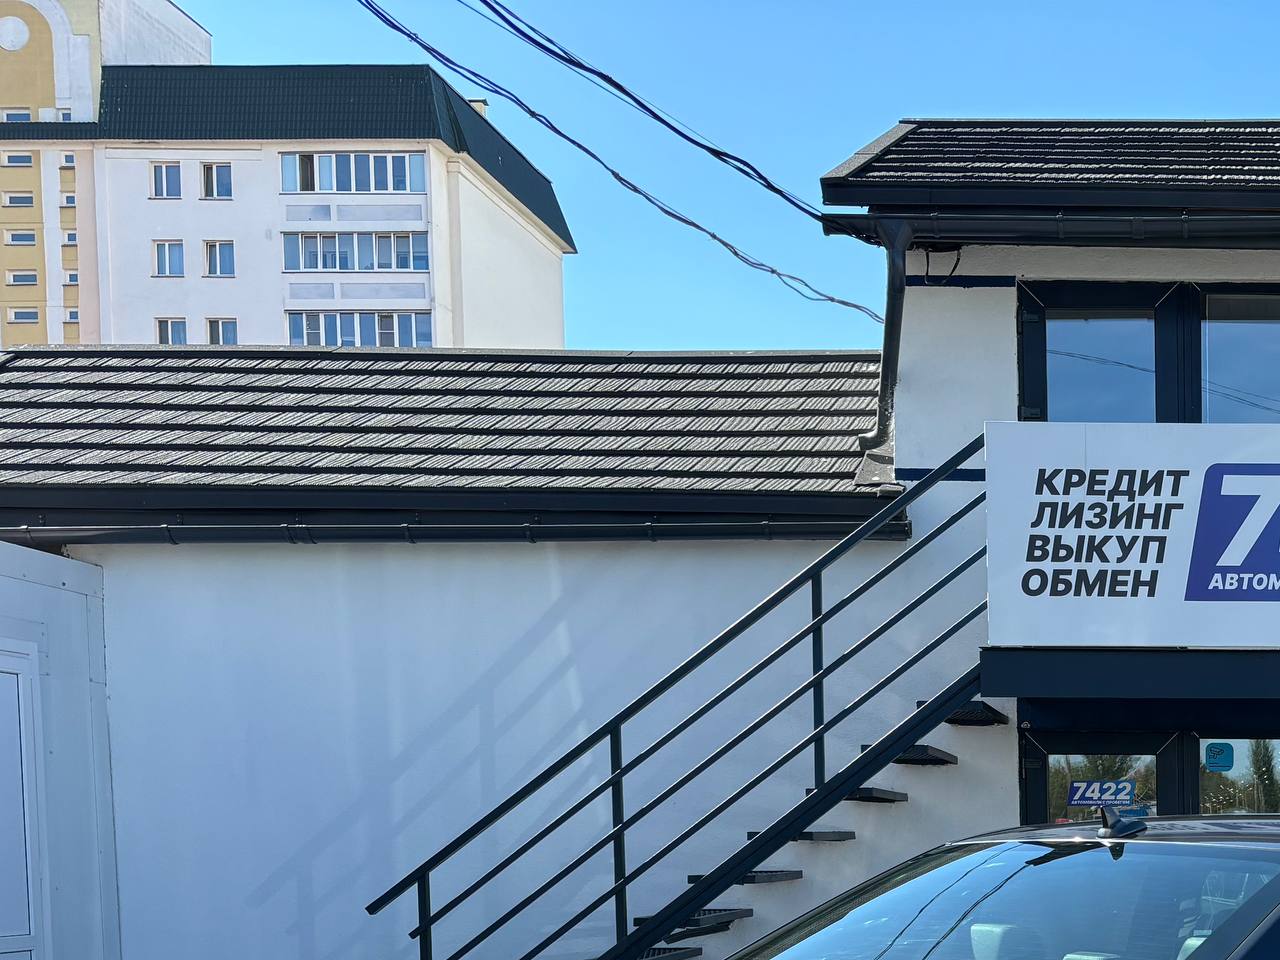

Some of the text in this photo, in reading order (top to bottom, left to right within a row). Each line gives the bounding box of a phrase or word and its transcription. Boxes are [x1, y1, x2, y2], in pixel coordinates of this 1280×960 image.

[1034, 468, 1190, 502] КРЕДИТ
[1029, 502, 1185, 530] ЛИЗИНГ
[1025, 534, 1167, 564] ВЫКУП
[1020, 567, 1159, 598] ОБМЕН
[1073, 782, 1132, 800] 7422
